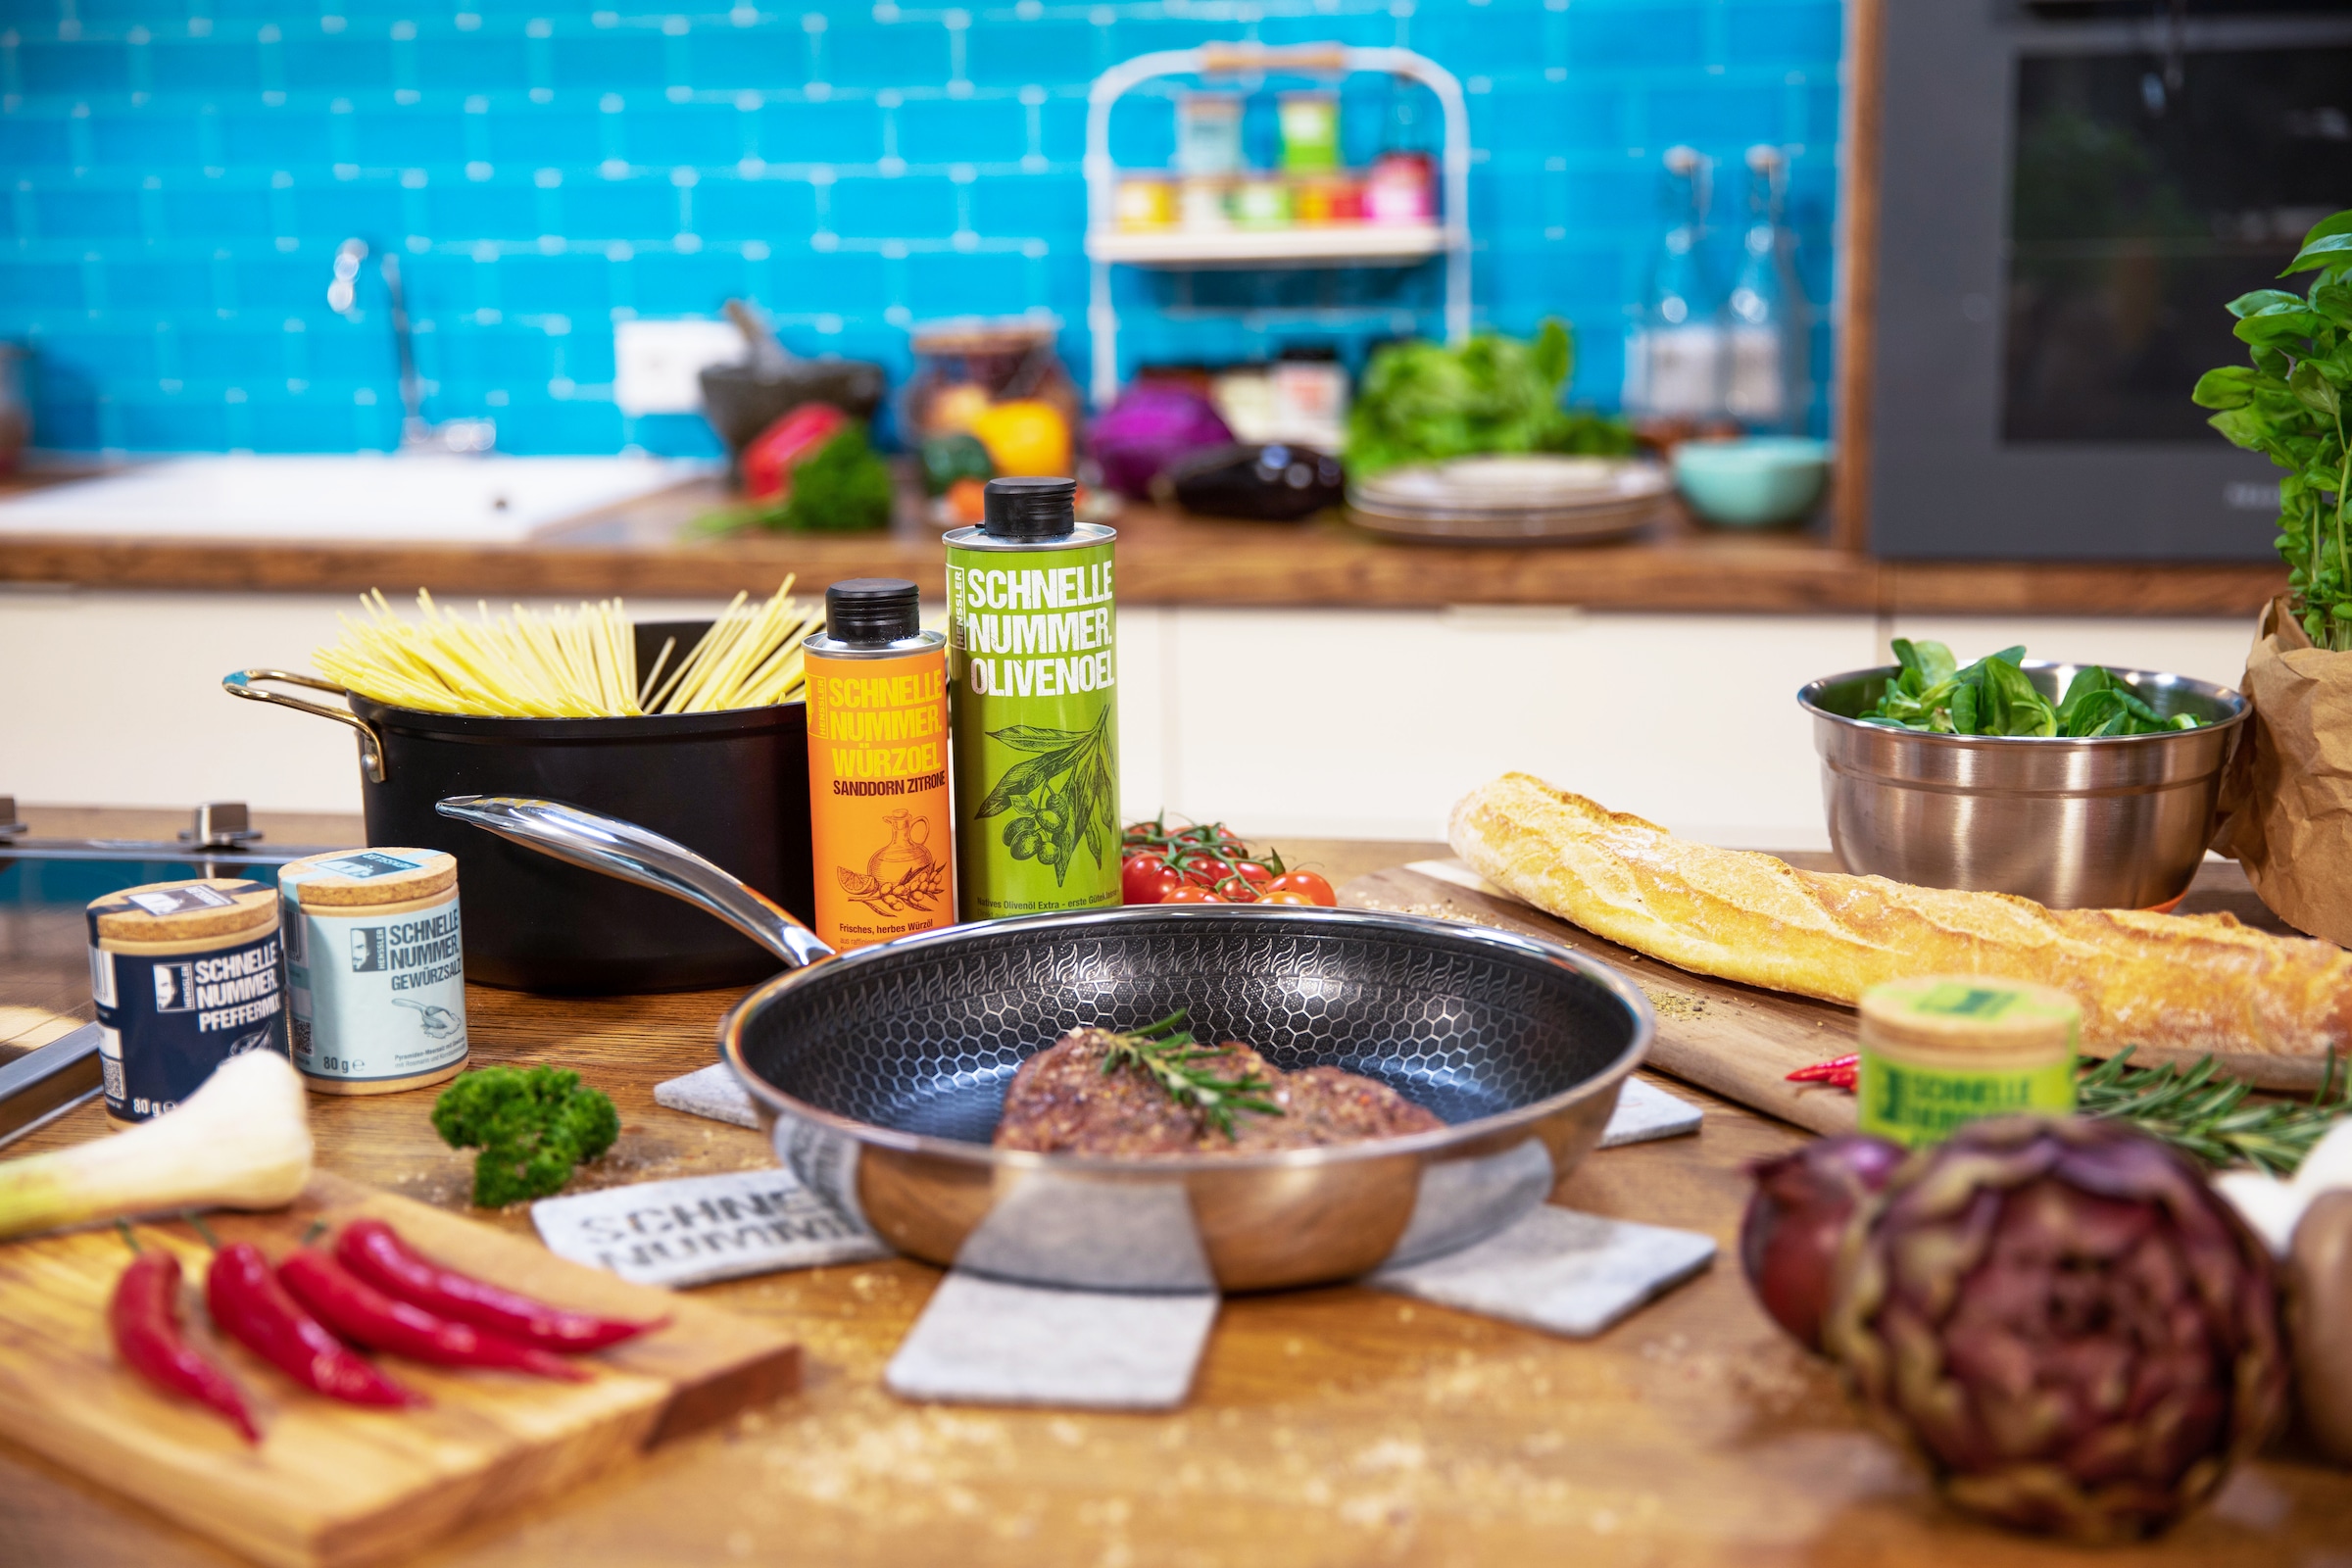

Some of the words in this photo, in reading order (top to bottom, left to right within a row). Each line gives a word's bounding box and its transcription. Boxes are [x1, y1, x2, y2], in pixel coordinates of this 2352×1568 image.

[967, 560, 1113, 610] SCHNELLE
[955, 570, 965, 647] HENSSLER
[968, 607, 1112, 654] NUMMER.
[829, 668, 943, 708] SCHNELLE
[970, 650, 1115, 697] OLIVENOEL
[817, 679, 827, 736] HENSSLER
[830, 704, 942, 742] NUMMER.
[832, 742, 941, 777] WÜRZOEL
[833, 779, 906, 797] SANDDORN
[906, 770, 946, 794] ZITRONE
[977, 897, 1002, 908] Natives
[1004, 900, 1036, 910] Olivenöl
[1038, 901, 1059, 909] Extra
[1067, 897, 1087, 907] erste
[389, 909, 460, 947] SCHNELLE
[839, 922, 875, 935] Frisches,
[876, 925, 906, 935] herbes
[907, 918, 933, 932] Würzöl
[195, 941, 278, 984] SCHNELLE
[375, 928, 385, 970] HENSSLER
[389, 934, 460, 970] NUMMER.
[196, 967, 279, 1009] NUMMER.
[391, 956, 463, 991] GEWÜRZSALZ
[198, 992, 282, 1034] PFEFFERMIX
[322, 1056, 338, 1071] 80
[341, 1060, 349, 1074] g
[132, 1098, 149, 1114] 80
[151, 1101, 162, 1117] g
[580, 1187, 821, 1246] SCHNE
